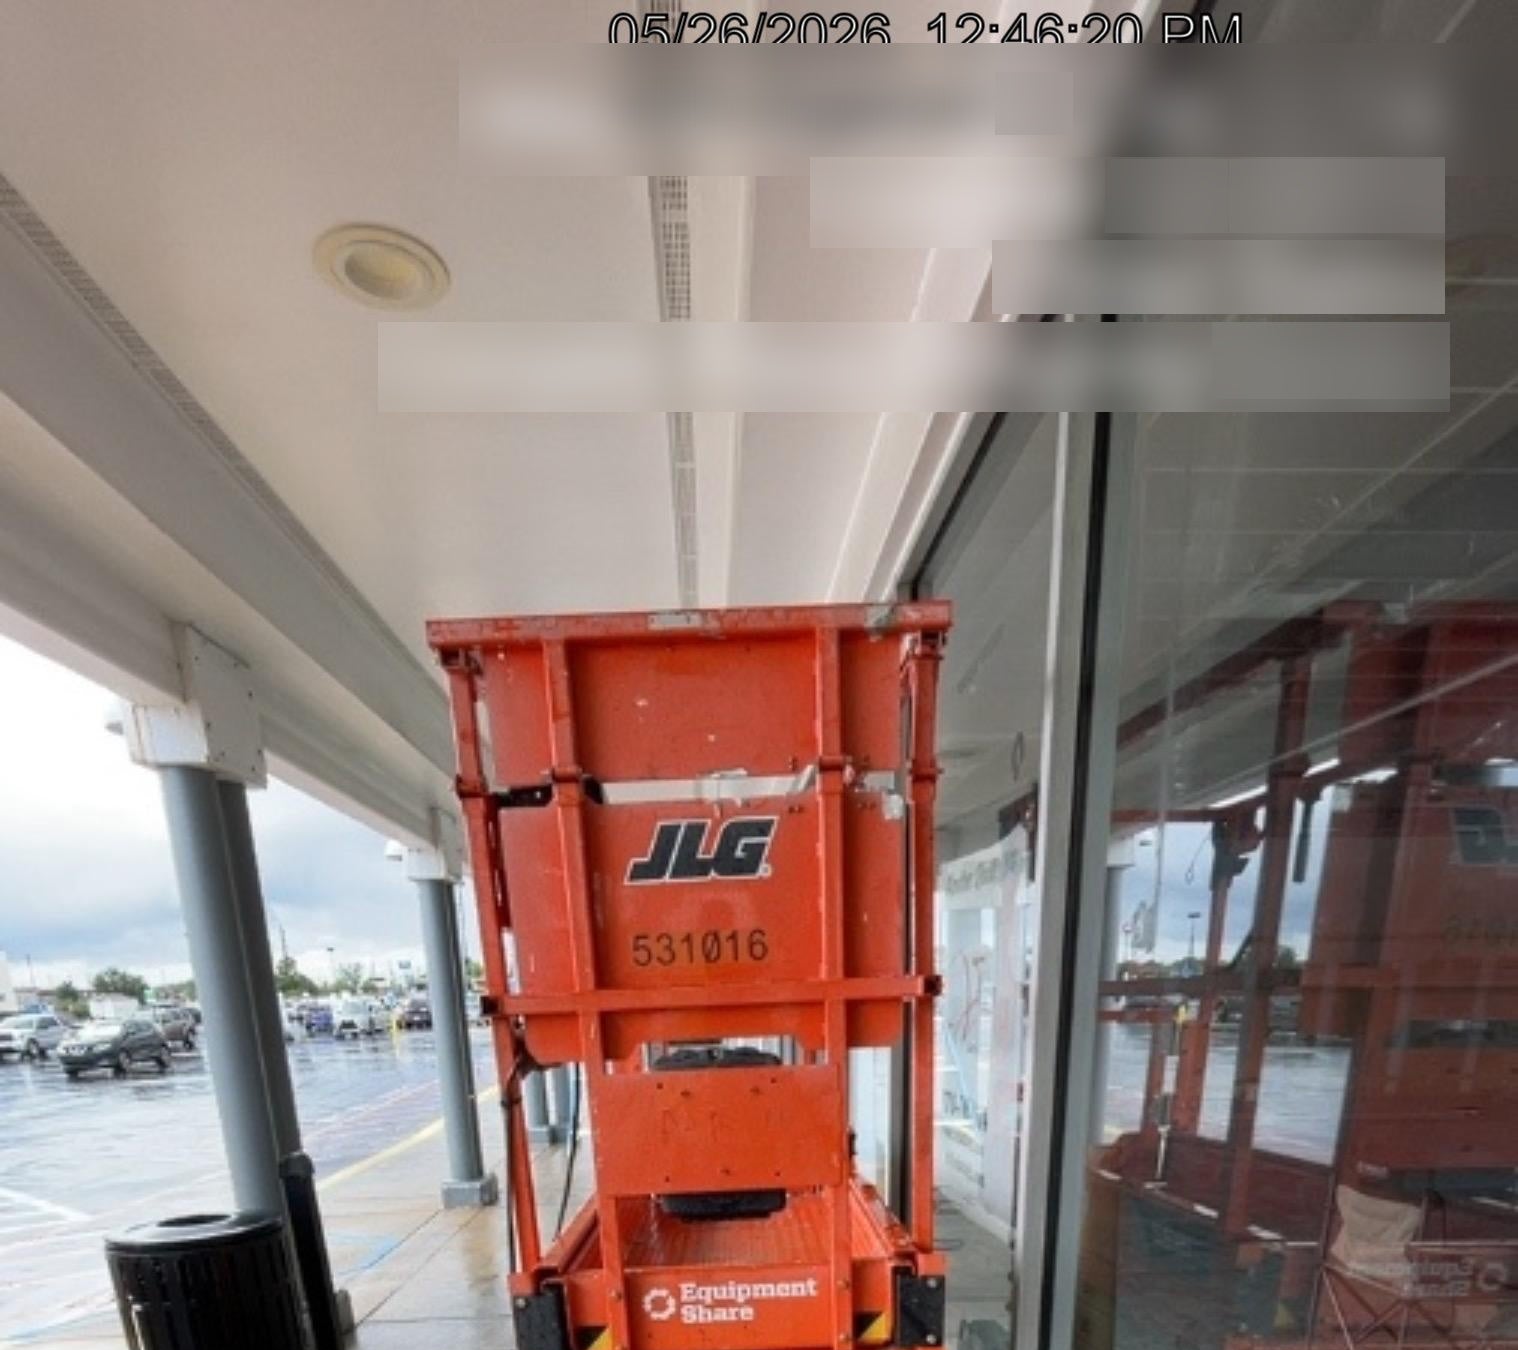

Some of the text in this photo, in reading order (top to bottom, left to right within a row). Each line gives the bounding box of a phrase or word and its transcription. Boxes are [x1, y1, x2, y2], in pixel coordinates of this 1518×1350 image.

[624, 815, 779, 885] JLG
[633, 929, 768, 966] 531016
[679, 1278, 817, 1304] Equipment
[681, 1305, 754, 1324] Share
